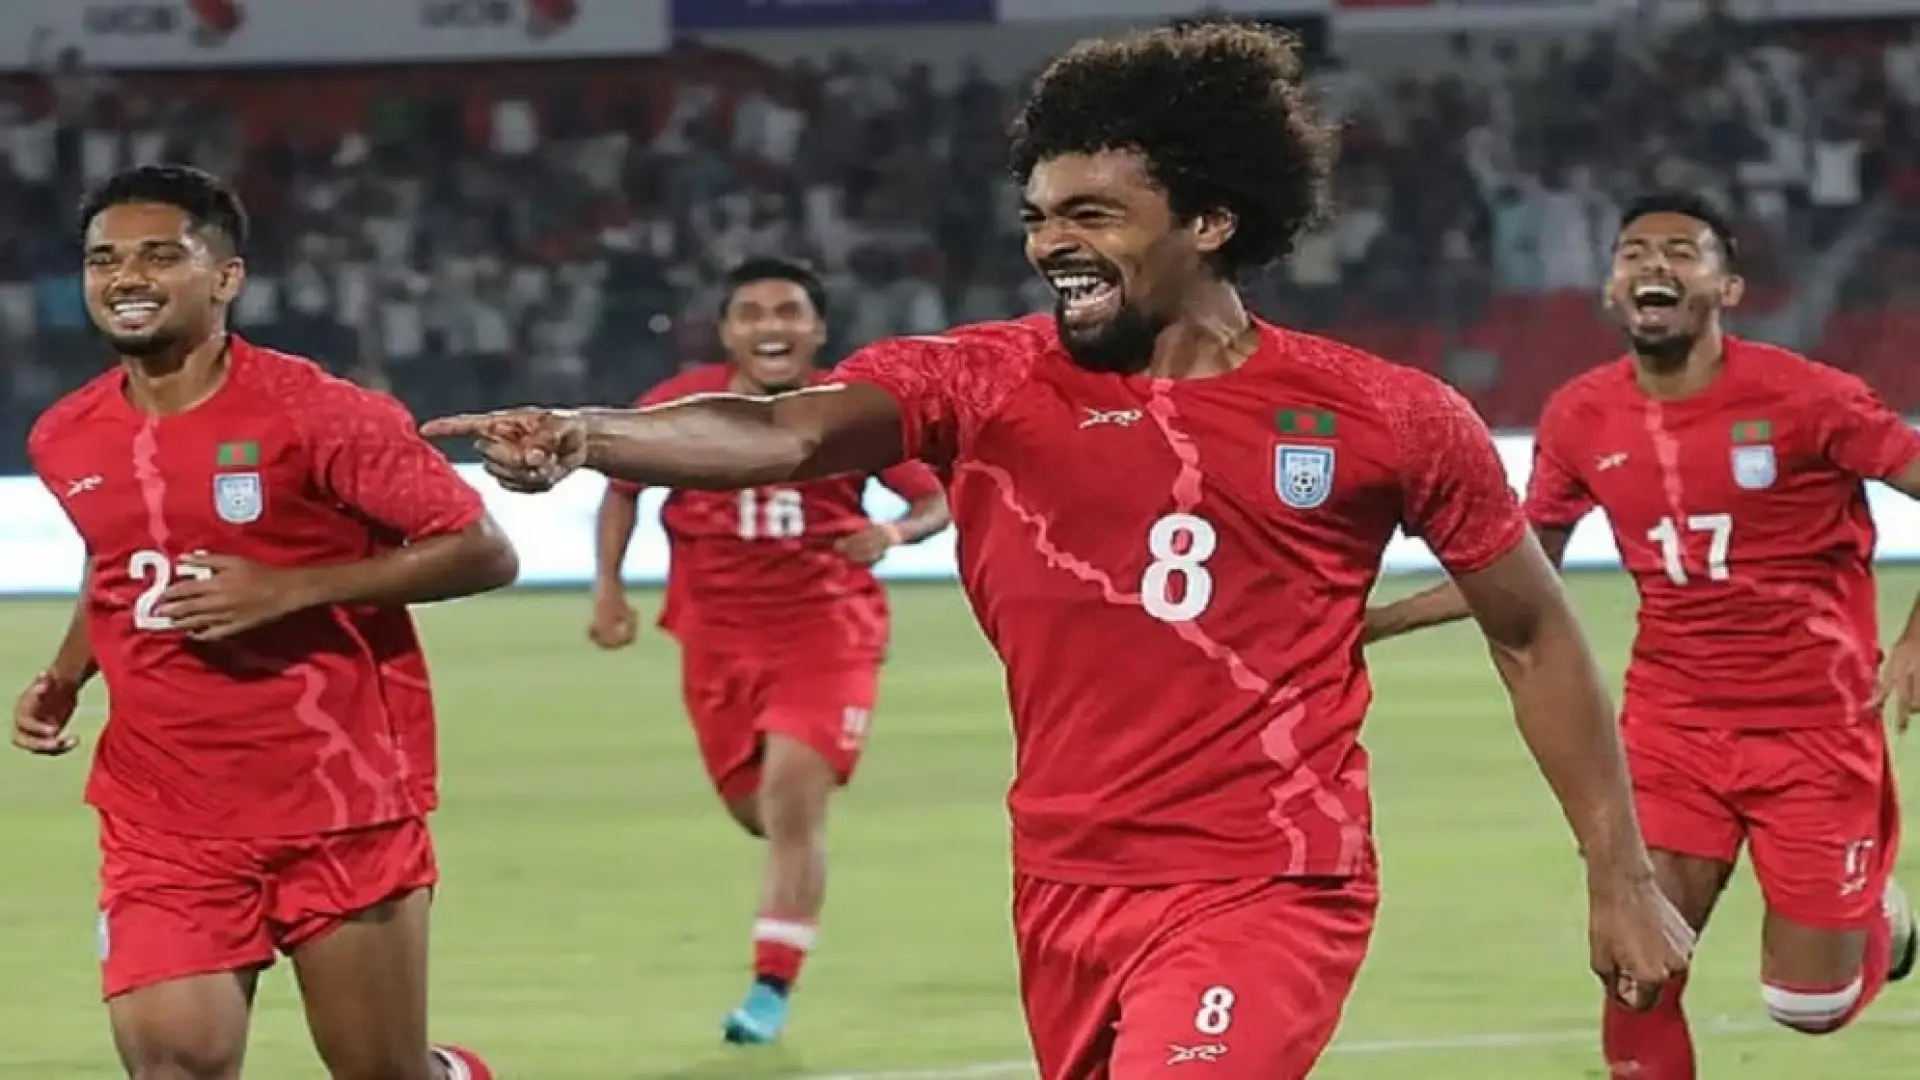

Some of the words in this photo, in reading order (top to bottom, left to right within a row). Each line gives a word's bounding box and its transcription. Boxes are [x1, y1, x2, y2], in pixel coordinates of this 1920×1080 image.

[737, 488, 804, 539] 16
[1141, 513, 1216, 622] 8
[1647, 514, 1733, 585] 17
[1195, 985, 1235, 1034] 8
